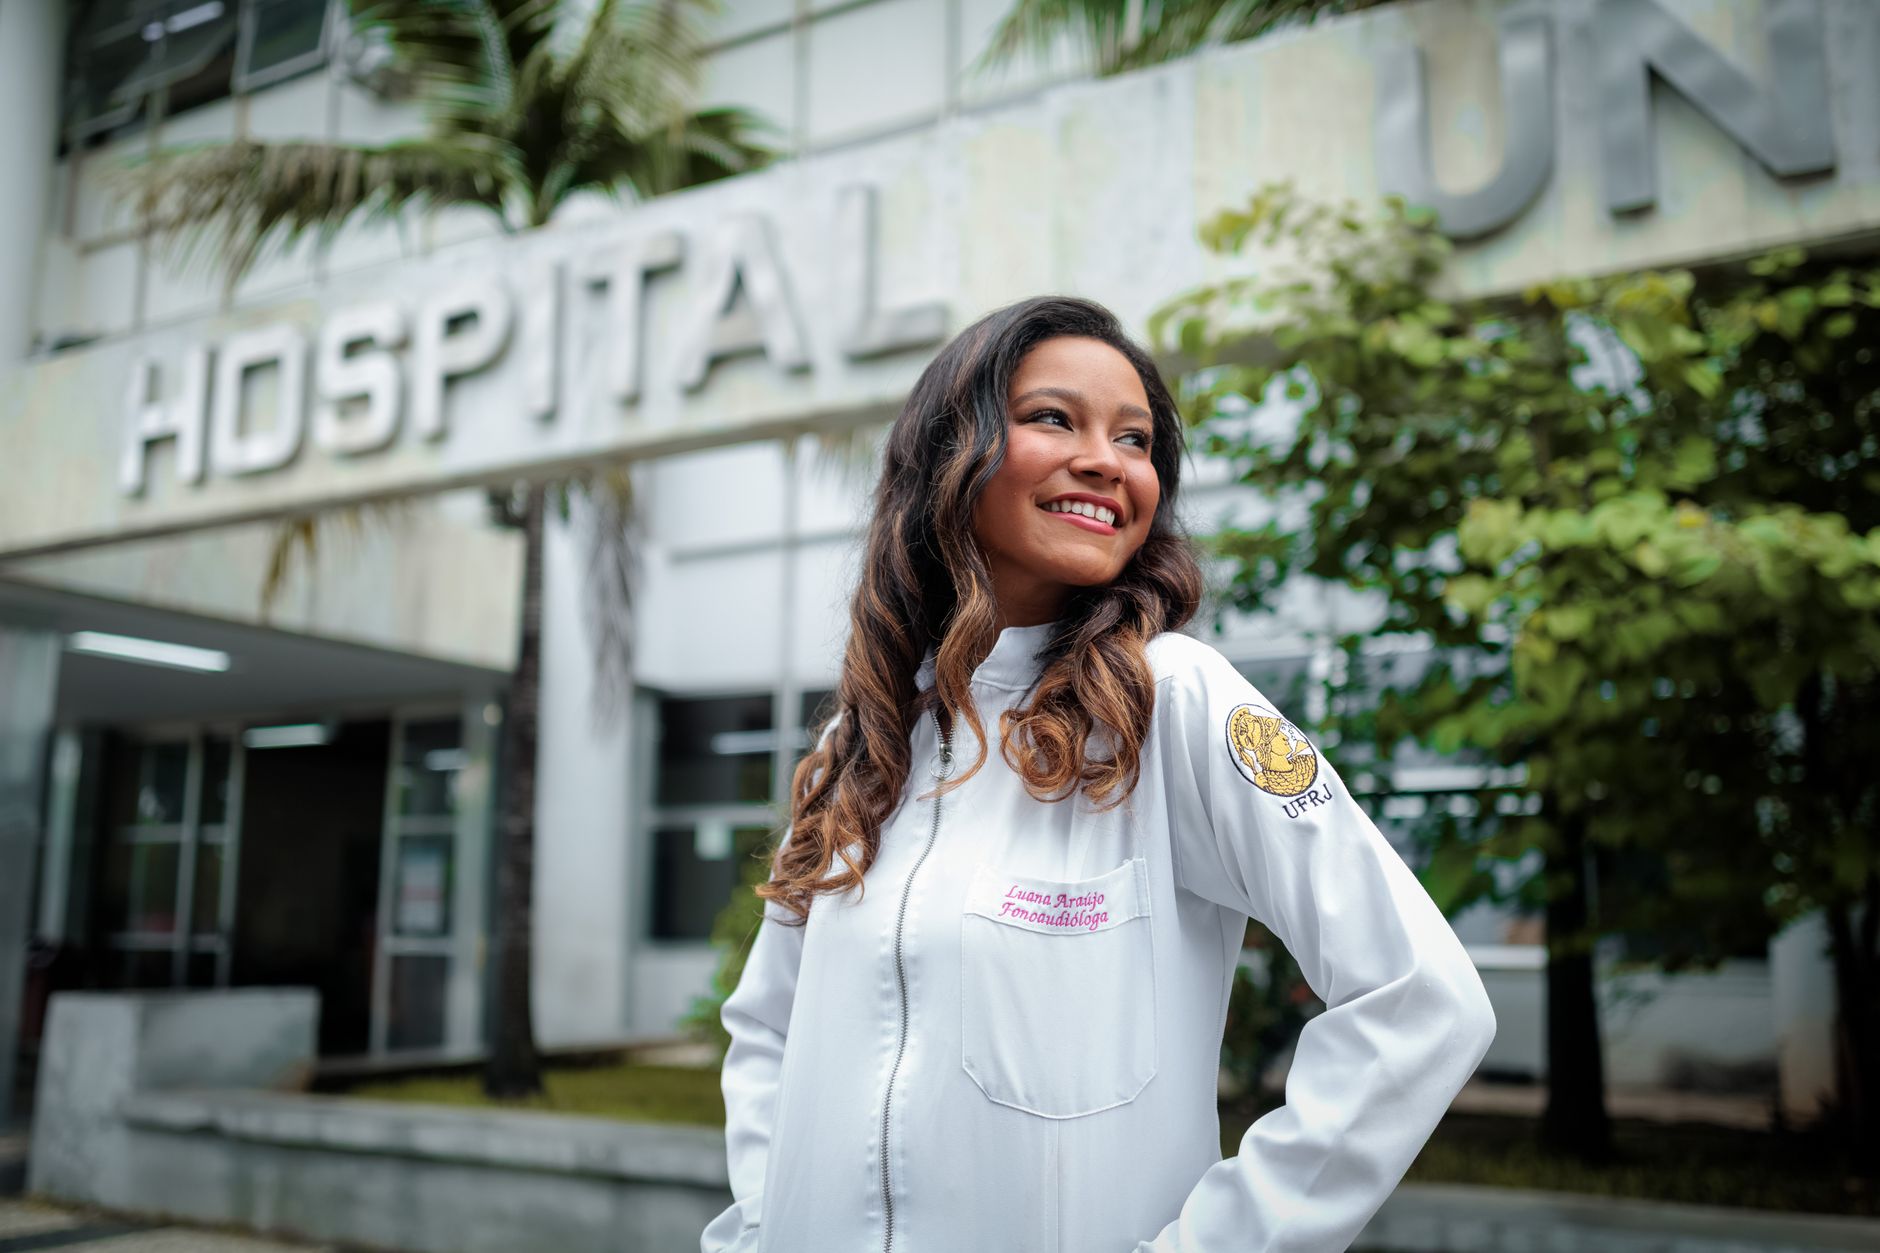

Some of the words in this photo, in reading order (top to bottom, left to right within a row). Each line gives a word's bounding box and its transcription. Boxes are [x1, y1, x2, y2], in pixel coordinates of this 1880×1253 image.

[119, 183, 950, 498] HOSPITAL
[1282, 783, 1333, 819] UFRJ
[1005, 885, 1051, 905] Luana
[1053, 892, 1105, 912] Araújo
[998, 902, 1109, 931] Fonoaudióloga
